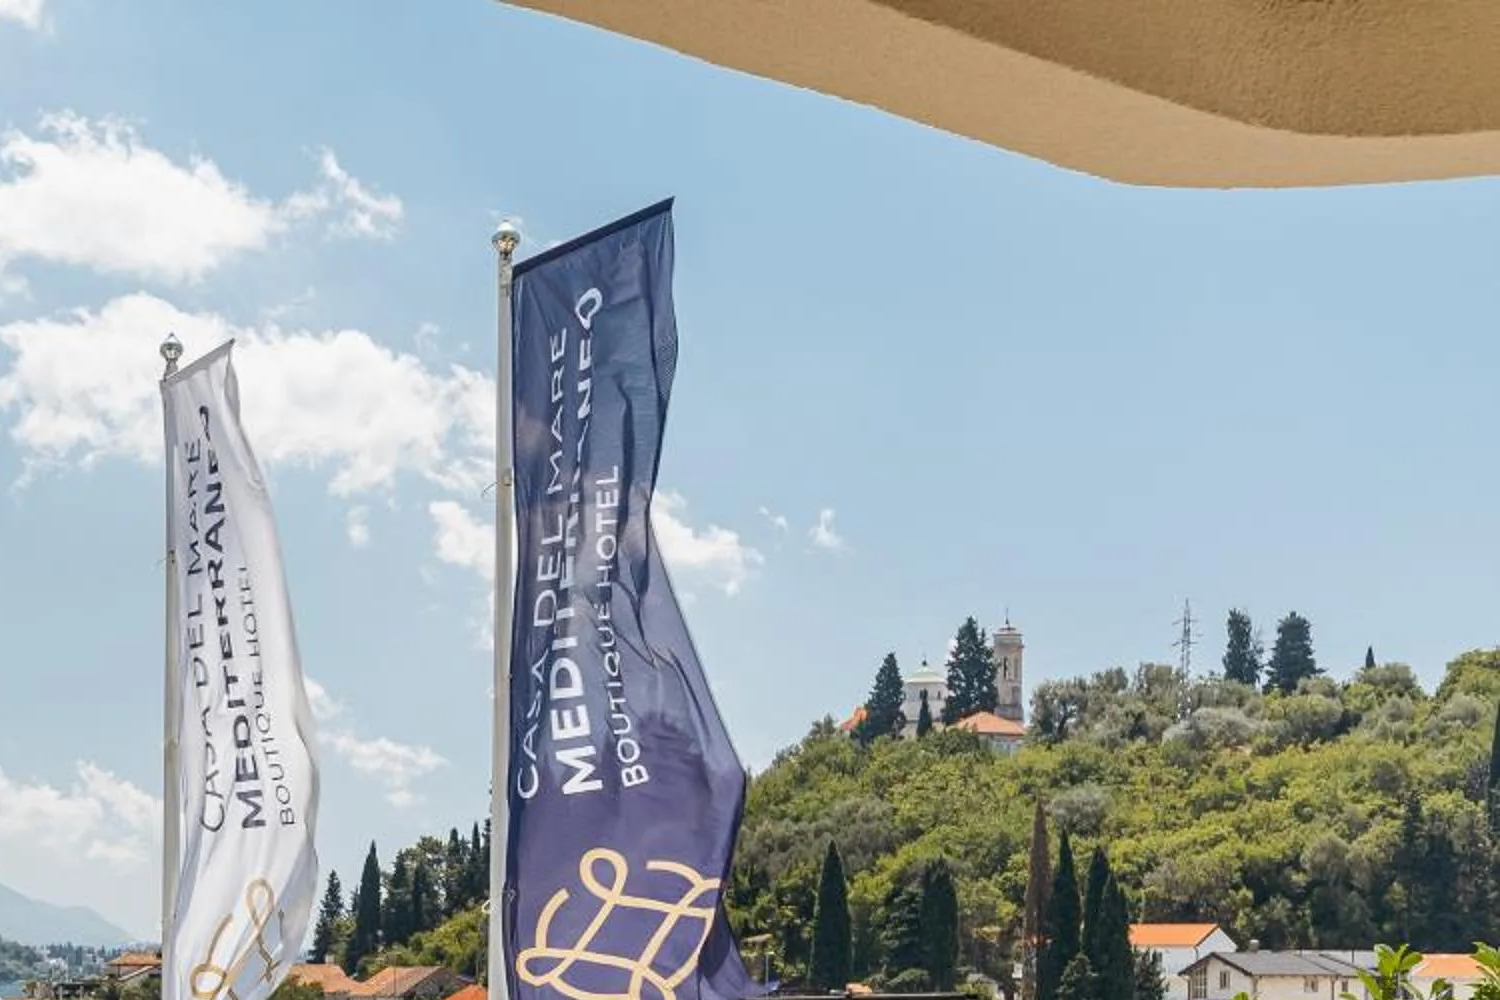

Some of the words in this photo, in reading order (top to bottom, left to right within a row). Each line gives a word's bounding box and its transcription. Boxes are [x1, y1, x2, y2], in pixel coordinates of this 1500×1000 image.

[545, 326, 568, 496] MARE
[183, 437, 204, 577] MARE
[532, 512, 564, 628] DEL
[549, 286, 604, 797] MEDITERNEO
[594, 464, 621, 589] HOTEL
[186, 592, 210, 689] DEL
[595, 601, 650, 789] BOUTIQUE
[250, 669, 296, 827] BOUTIQUE
[516, 648, 549, 800] CASA
